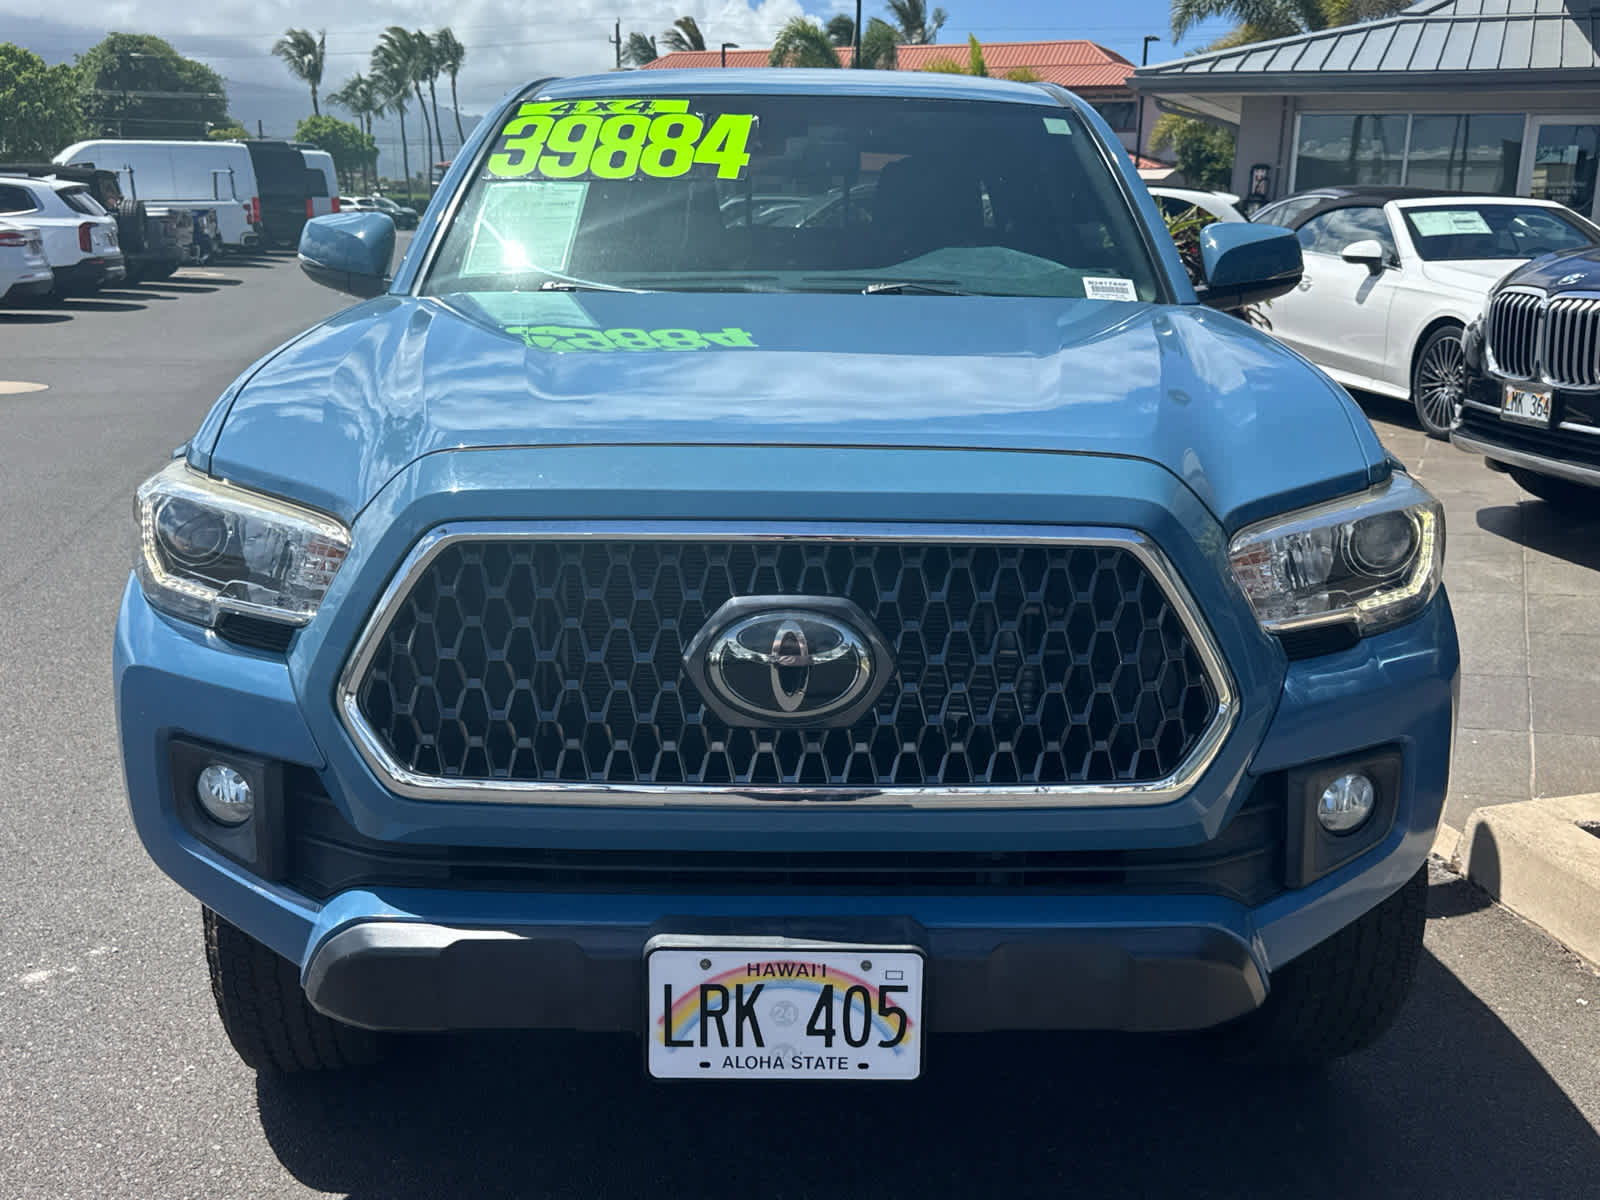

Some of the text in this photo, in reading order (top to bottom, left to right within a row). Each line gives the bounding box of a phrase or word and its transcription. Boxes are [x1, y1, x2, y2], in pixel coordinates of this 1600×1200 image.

[487, 113, 753, 179] 39884
[1530, 395, 1550, 417] 364
[664, 984, 908, 1048] LRK 405
[722, 1055, 785, 1069] ALOHA
[791, 1056, 849, 1070] STATE
